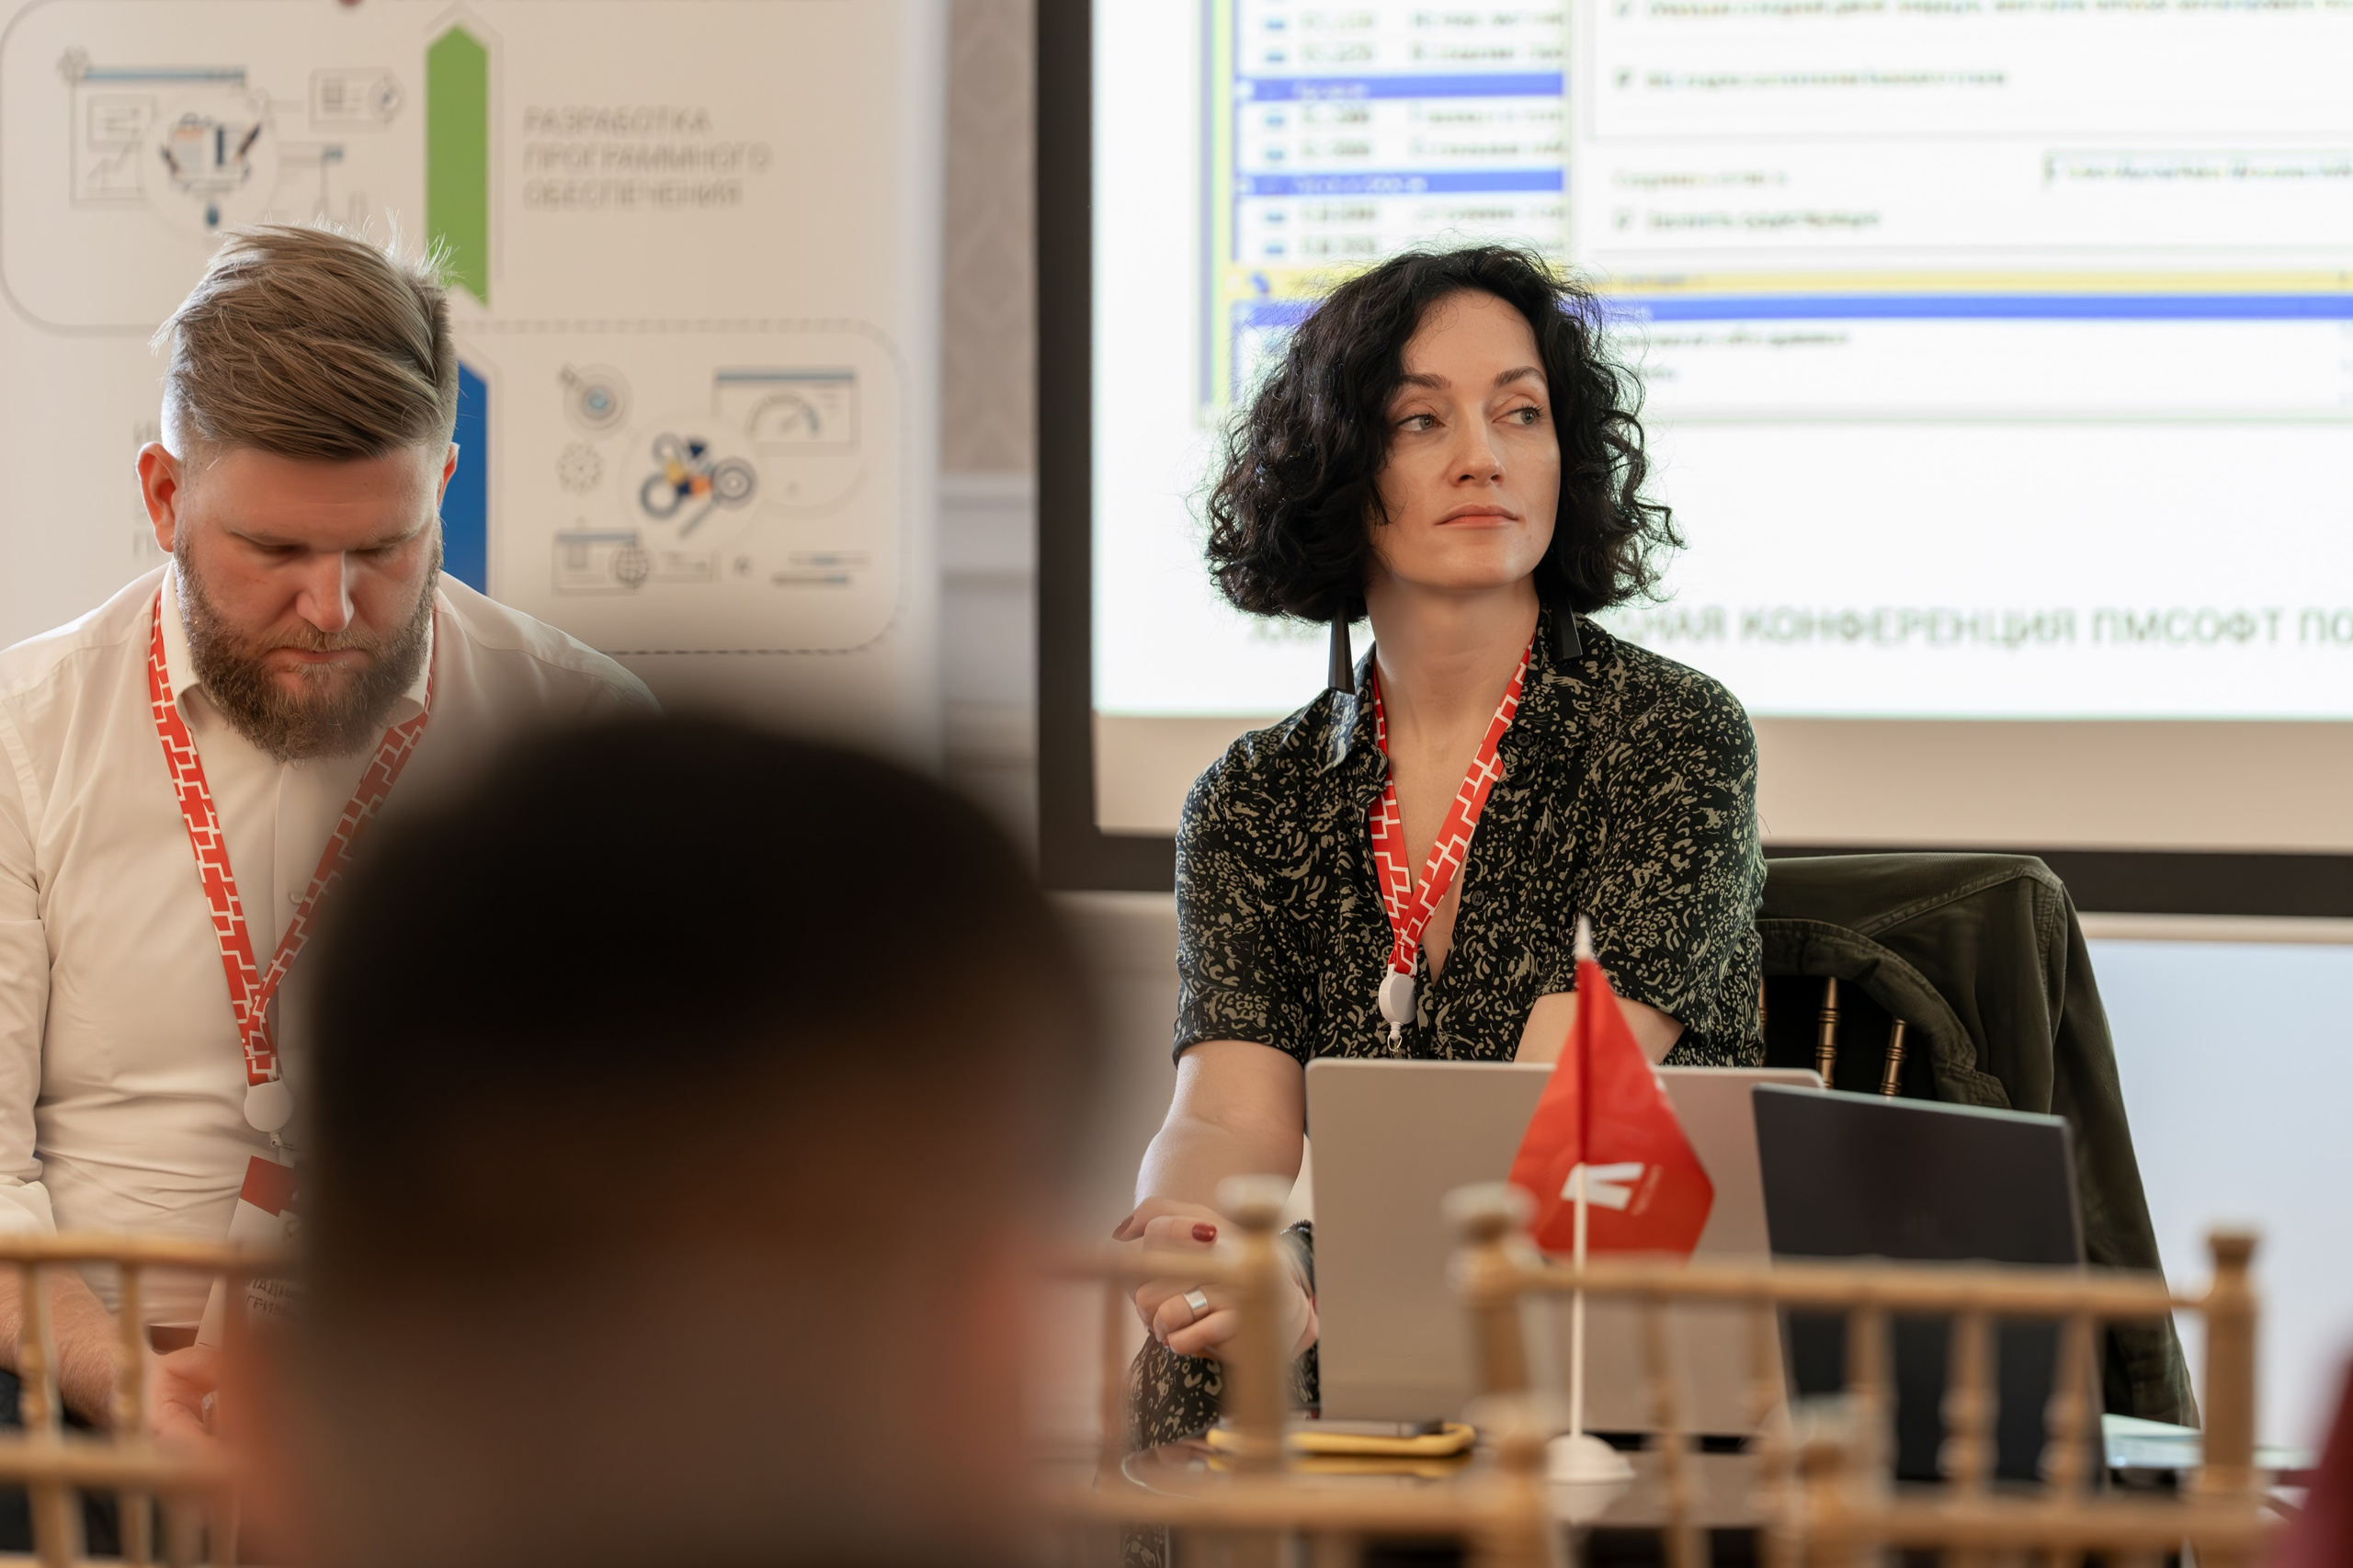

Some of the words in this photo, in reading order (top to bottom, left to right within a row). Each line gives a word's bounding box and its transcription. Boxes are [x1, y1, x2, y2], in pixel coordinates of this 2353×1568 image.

[523, 105, 715, 136] РАЗРАБОТКА
[522, 142, 774, 175] ПРОГРАММНОГО
[522, 178, 744, 211] ОБЕСПЕЧЕНИЯ
[1741, 607, 2076, 652] КОНФЕРЕНЦИЯ
[2091, 606, 2284, 645] ПМСОФТ
